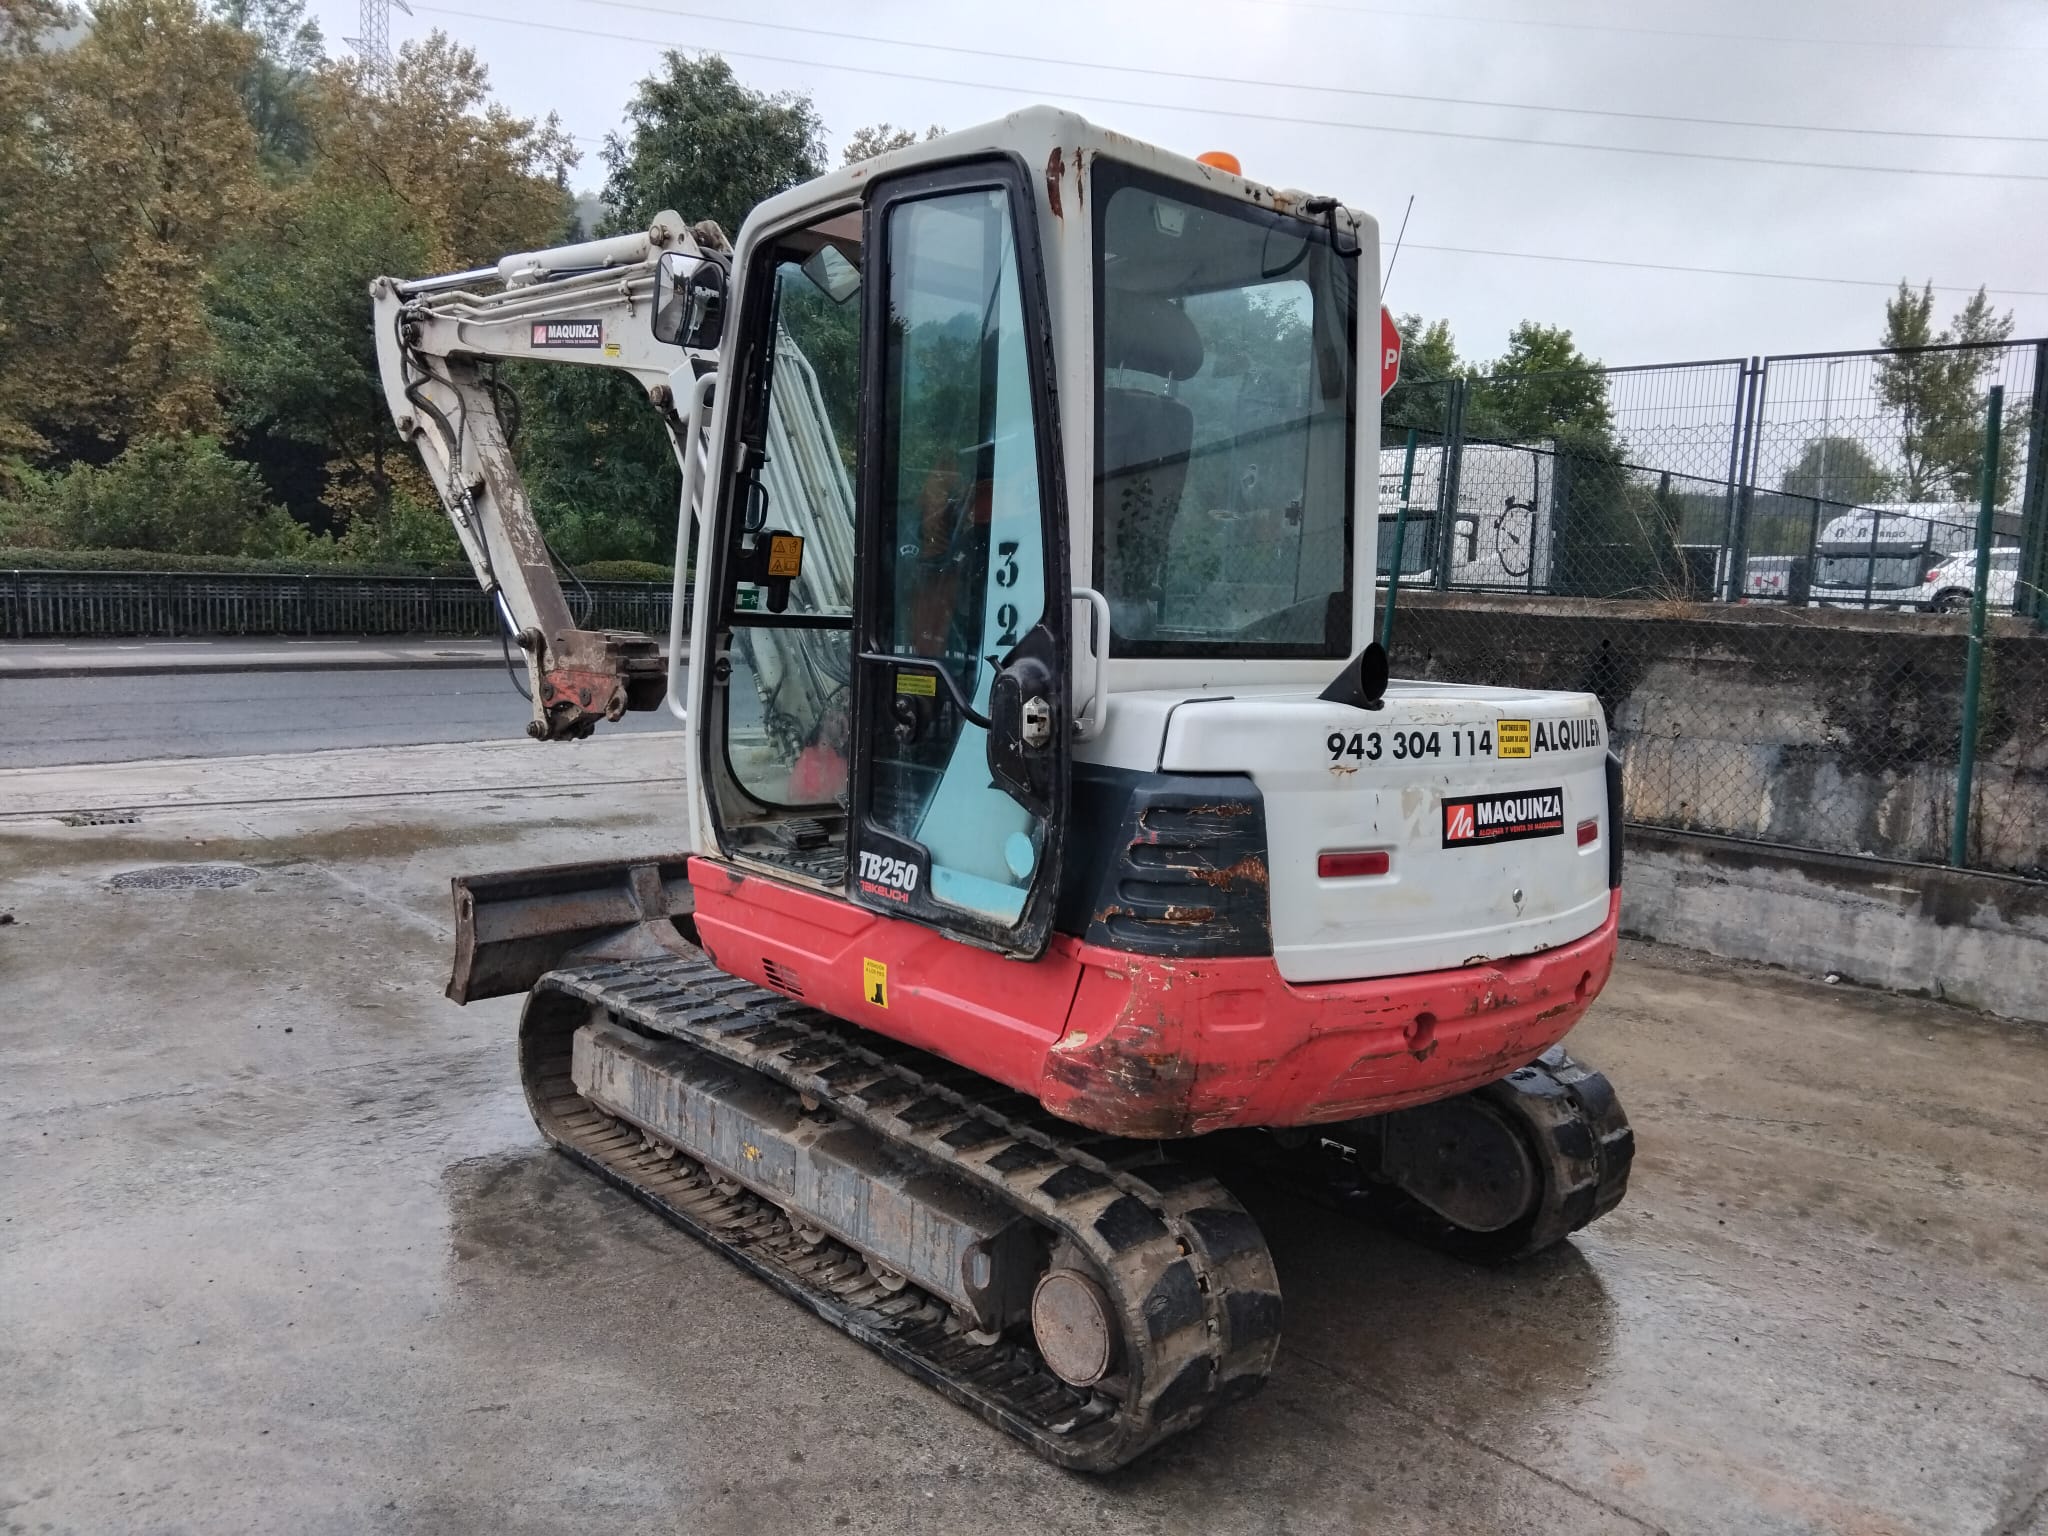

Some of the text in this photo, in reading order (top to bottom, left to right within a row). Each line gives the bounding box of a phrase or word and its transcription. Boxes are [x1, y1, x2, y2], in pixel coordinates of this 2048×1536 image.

[548, 325, 599, 338] MAQUINZA
[1327, 730, 1493, 761] 943 304 114
[1534, 719, 1601, 753] ALQUILER
[1477, 795, 1561, 825] MAQUINZA
[859, 850, 918, 892] TB250
